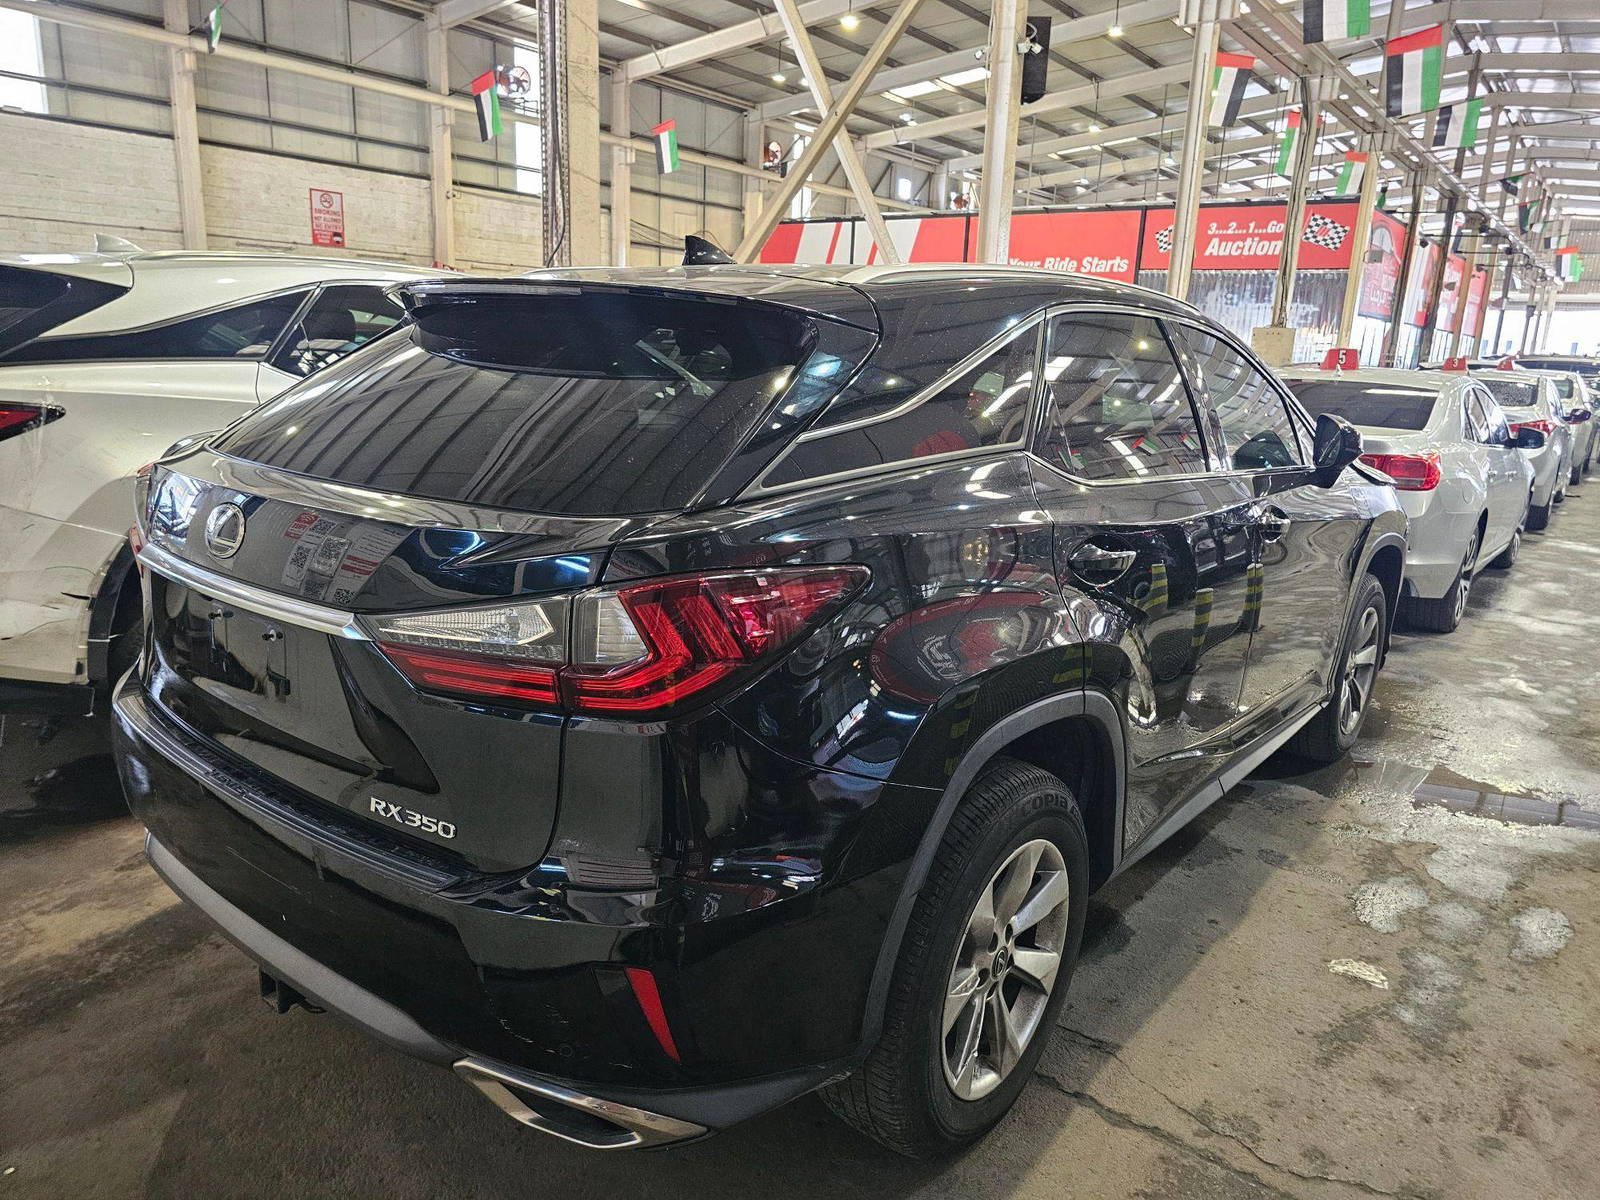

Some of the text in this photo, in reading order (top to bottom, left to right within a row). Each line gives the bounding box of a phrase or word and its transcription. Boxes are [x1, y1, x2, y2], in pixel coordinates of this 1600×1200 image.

[1203, 236, 1283, 256] Auction
[1044, 256, 1078, 272] Ride
[1080, 256, 1129, 273] Starts
[1338, 349, 1347, 366] 5
[1452, 358, 1458, 368] 3
